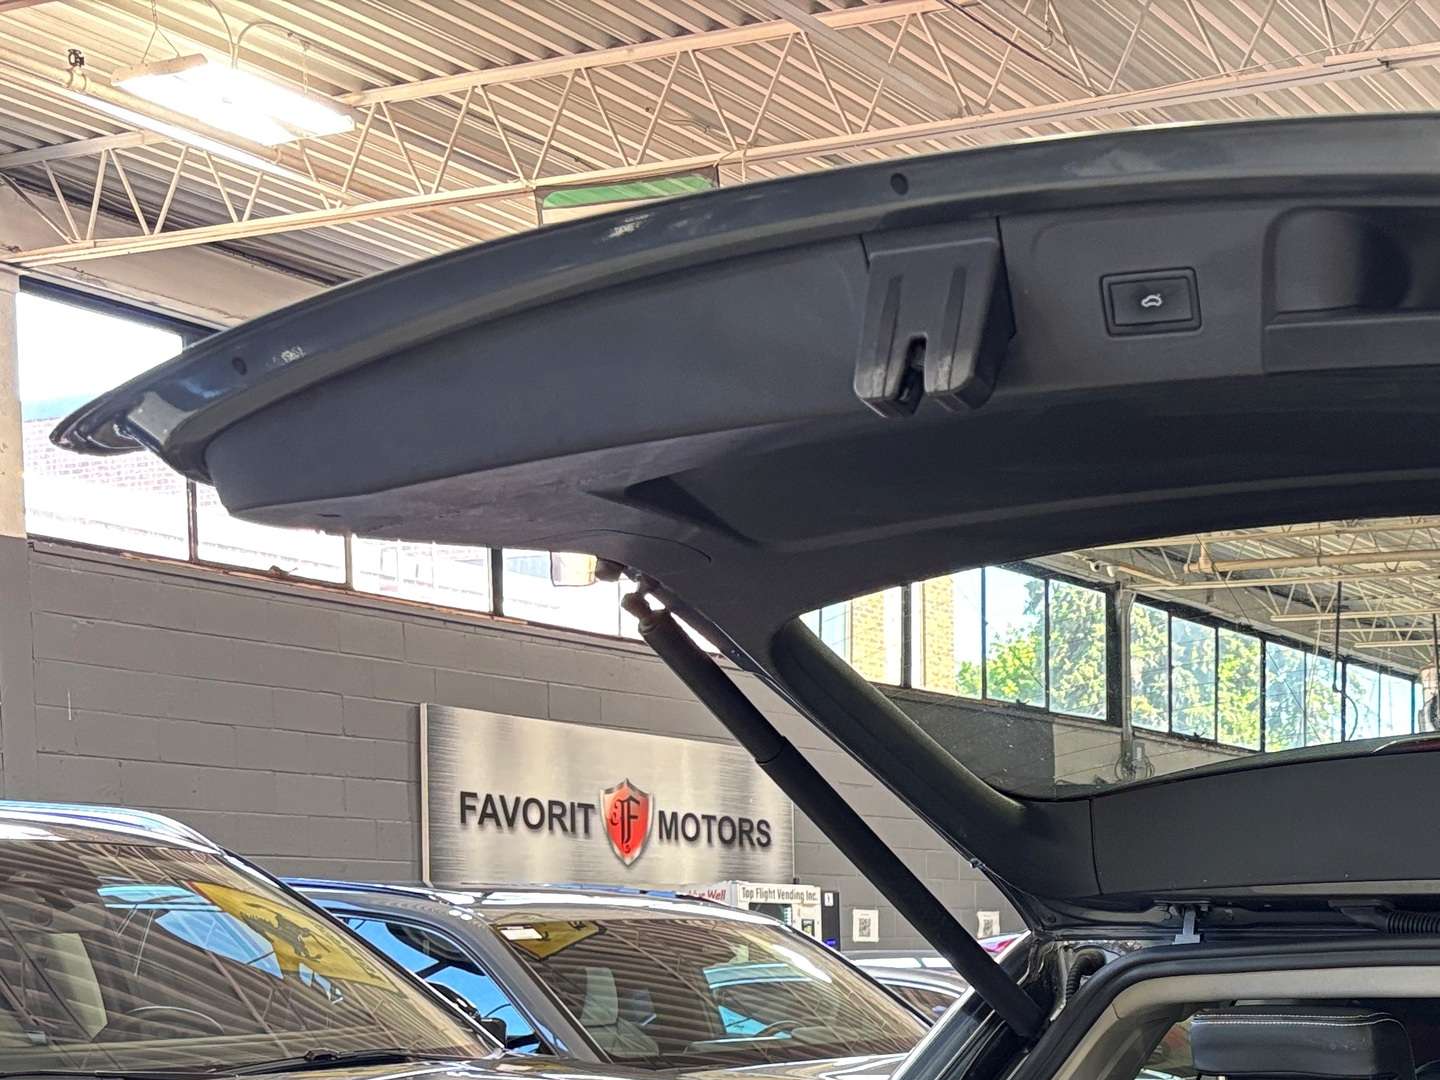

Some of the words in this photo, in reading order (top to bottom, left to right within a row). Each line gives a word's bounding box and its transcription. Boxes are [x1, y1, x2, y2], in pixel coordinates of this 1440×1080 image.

[459, 790, 596, 835] FAVORIT
[658, 809, 773, 848] MOTORS
[742, 886, 754, 899] Top
[756, 887, 776, 901] Flight
[777, 889, 804, 902] Vending
